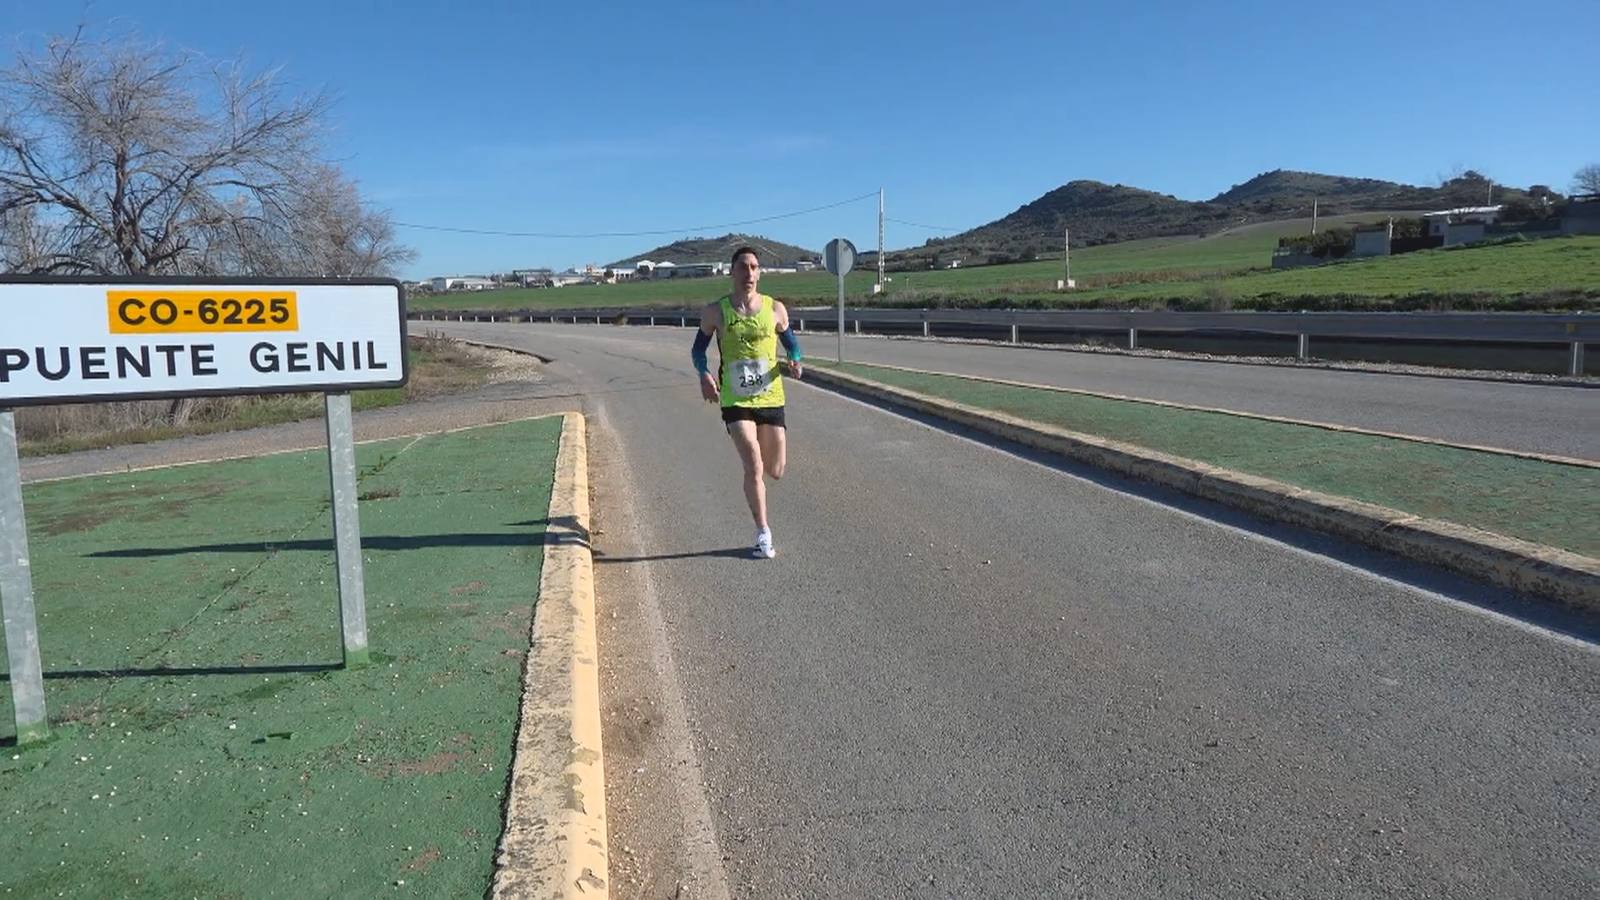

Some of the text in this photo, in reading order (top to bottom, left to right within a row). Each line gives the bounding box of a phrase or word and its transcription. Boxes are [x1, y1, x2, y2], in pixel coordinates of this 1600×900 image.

[118, 298, 290, 325] CO-6225
[0, 341, 388, 383] PUENTE GENIL
